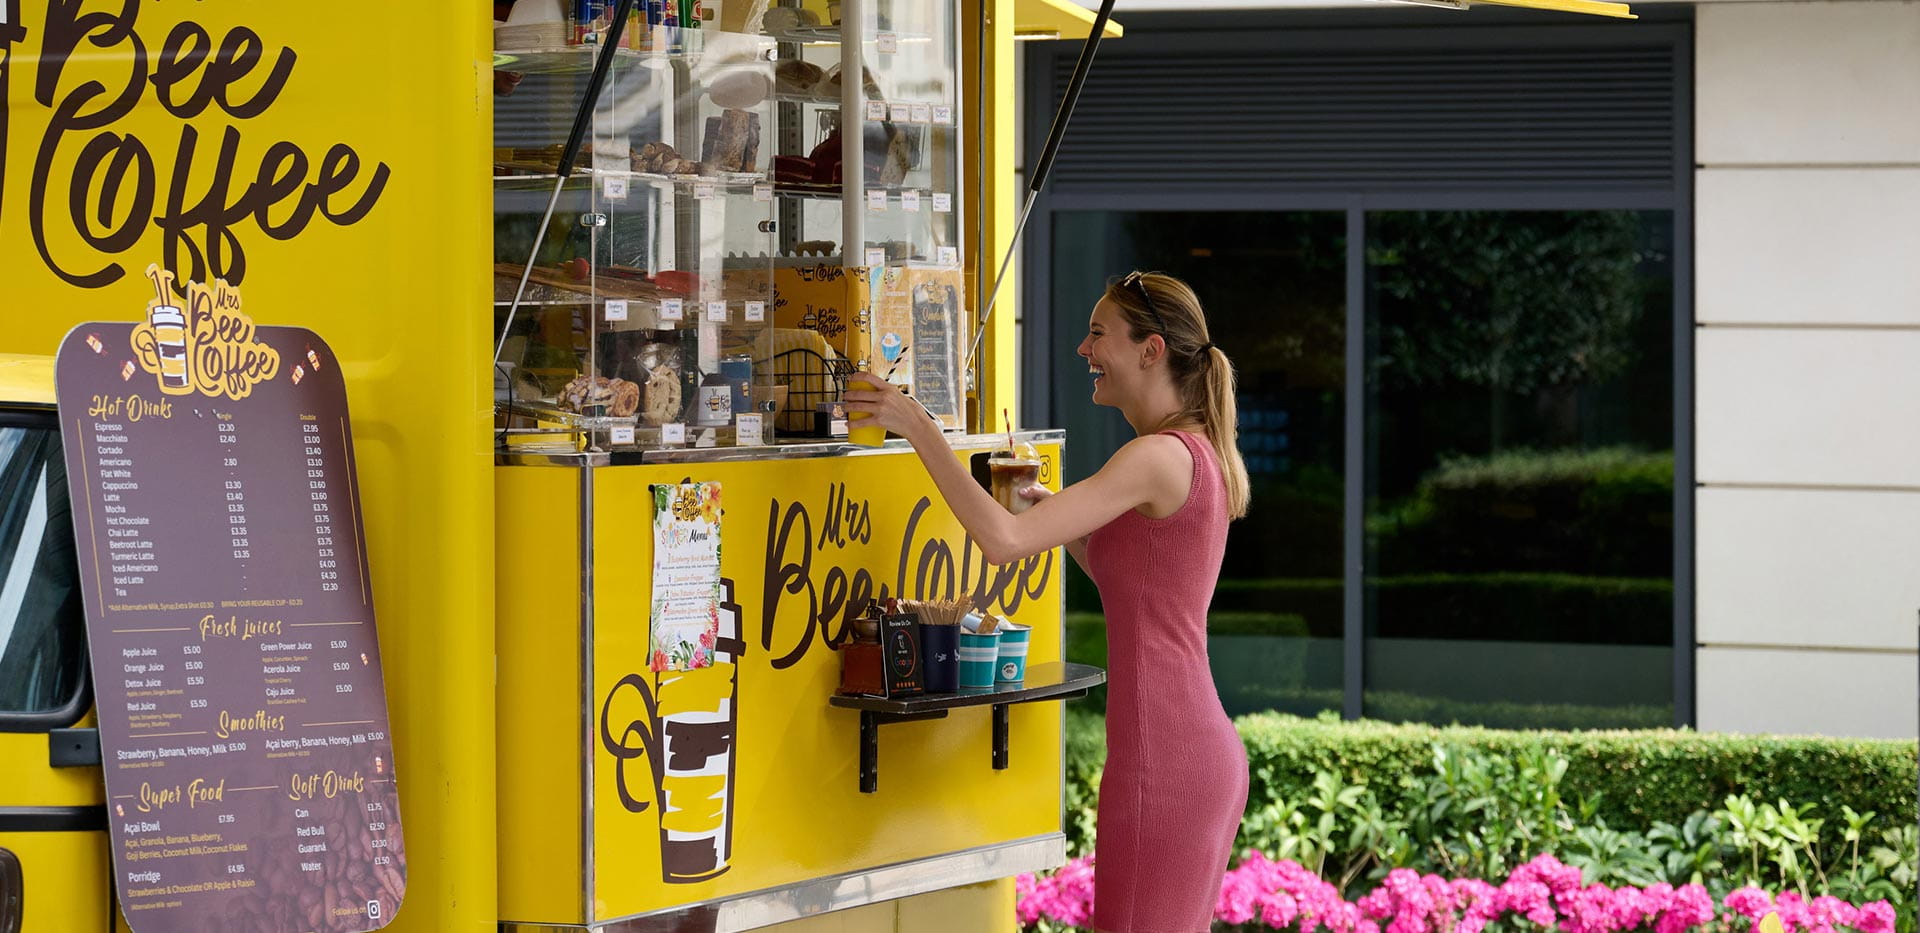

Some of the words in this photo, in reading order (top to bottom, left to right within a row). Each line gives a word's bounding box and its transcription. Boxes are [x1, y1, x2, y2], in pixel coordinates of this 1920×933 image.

[35, 0, 297, 130] Bee
[29, 80, 391, 298] Coffee
[215, 287, 240, 310] Mrs
[191, 289, 249, 345] Bee
[194, 331, 274, 395] Coffee
[88, 395, 124, 421] Hot
[126, 394, 172, 422] Drinks
[95, 423, 122, 432] Espresso
[96, 434, 128, 443] Macchiato
[220, 435, 236, 443] £2.40
[304, 436, 320, 444] £3.00
[97, 446, 123, 455] Cortado
[305, 447, 321, 455] £3.40
[99, 458, 132, 466] Americano
[101, 469, 114, 478] Flat
[113, 469, 131, 478] White
[102, 481, 138, 490] Cappuccino
[226, 492, 243, 500] £3.40
[105, 505, 126, 513] Mocha
[106, 517, 118, 525] Hot
[118, 516, 149, 525] Chocolate
[817, 481, 872, 551] Mrs
[108, 529, 122, 537] Chai
[122, 529, 138, 537] Latte
[689, 529, 708, 543] Menu
[109, 541, 136, 549] Beetroot
[136, 540, 152, 549] Latte
[111, 552, 138, 561] Turmeric
[138, 552, 154, 560] Latte
[112, 564, 126, 572] Iced
[126, 564, 158, 572] Americano
[319, 560, 336, 568] £4.00
[114, 576, 128, 585] Iced
[128, 576, 144, 584] Latte
[761, 497, 889, 669] Bee
[115, 588, 127, 596] Tea
[199, 614, 237, 641] Fresh
[260, 643, 278, 651] Green
[278, 642, 297, 650] Power
[297, 641, 312, 650] Juice
[330, 641, 347, 649] £5.00
[122, 649, 140, 658] Apple
[141, 648, 157, 656] Juice
[183, 646, 201, 655] £5.00
[124, 664, 147, 674] Orange
[148, 663, 164, 672] Juice
[185, 661, 203, 670] £5.00
[263, 665, 285, 674] Acerola
[285, 664, 301, 673] Juice
[333, 662, 350, 671] £5.00
[125, 680, 143, 688] Detox
[145, 679, 161, 687] Juice
[279, 687, 295, 695] Juice
[335, 684, 352, 693] £5.00
[127, 703, 140, 711] Red
[141, 702, 156, 710] Juice
[217, 710, 284, 738] Smoothies
[302, 738, 328, 747] Banana,
[328, 736, 352, 746] Honey,
[352, 735, 366, 743] Milk
[367, 732, 384, 741] £5.00
[117, 750, 158, 760] Strawberry,
[158, 748, 187, 757] Banana,
[187, 746, 212, 756] Honey,
[212, 745, 227, 754] Milk
[228, 743, 246, 751] £5.00
[289, 773, 322, 800] Soft
[322, 770, 364, 799] Drinks
[137, 782, 181, 812] Super
[188, 778, 225, 808] Food
[295, 809, 309, 818] Can
[141, 821, 161, 832] Bowl
[297, 828, 311, 836] Red
[311, 826, 325, 835] Bull
[301, 862, 322, 871] Water
[128, 871, 161, 883] Porridge
